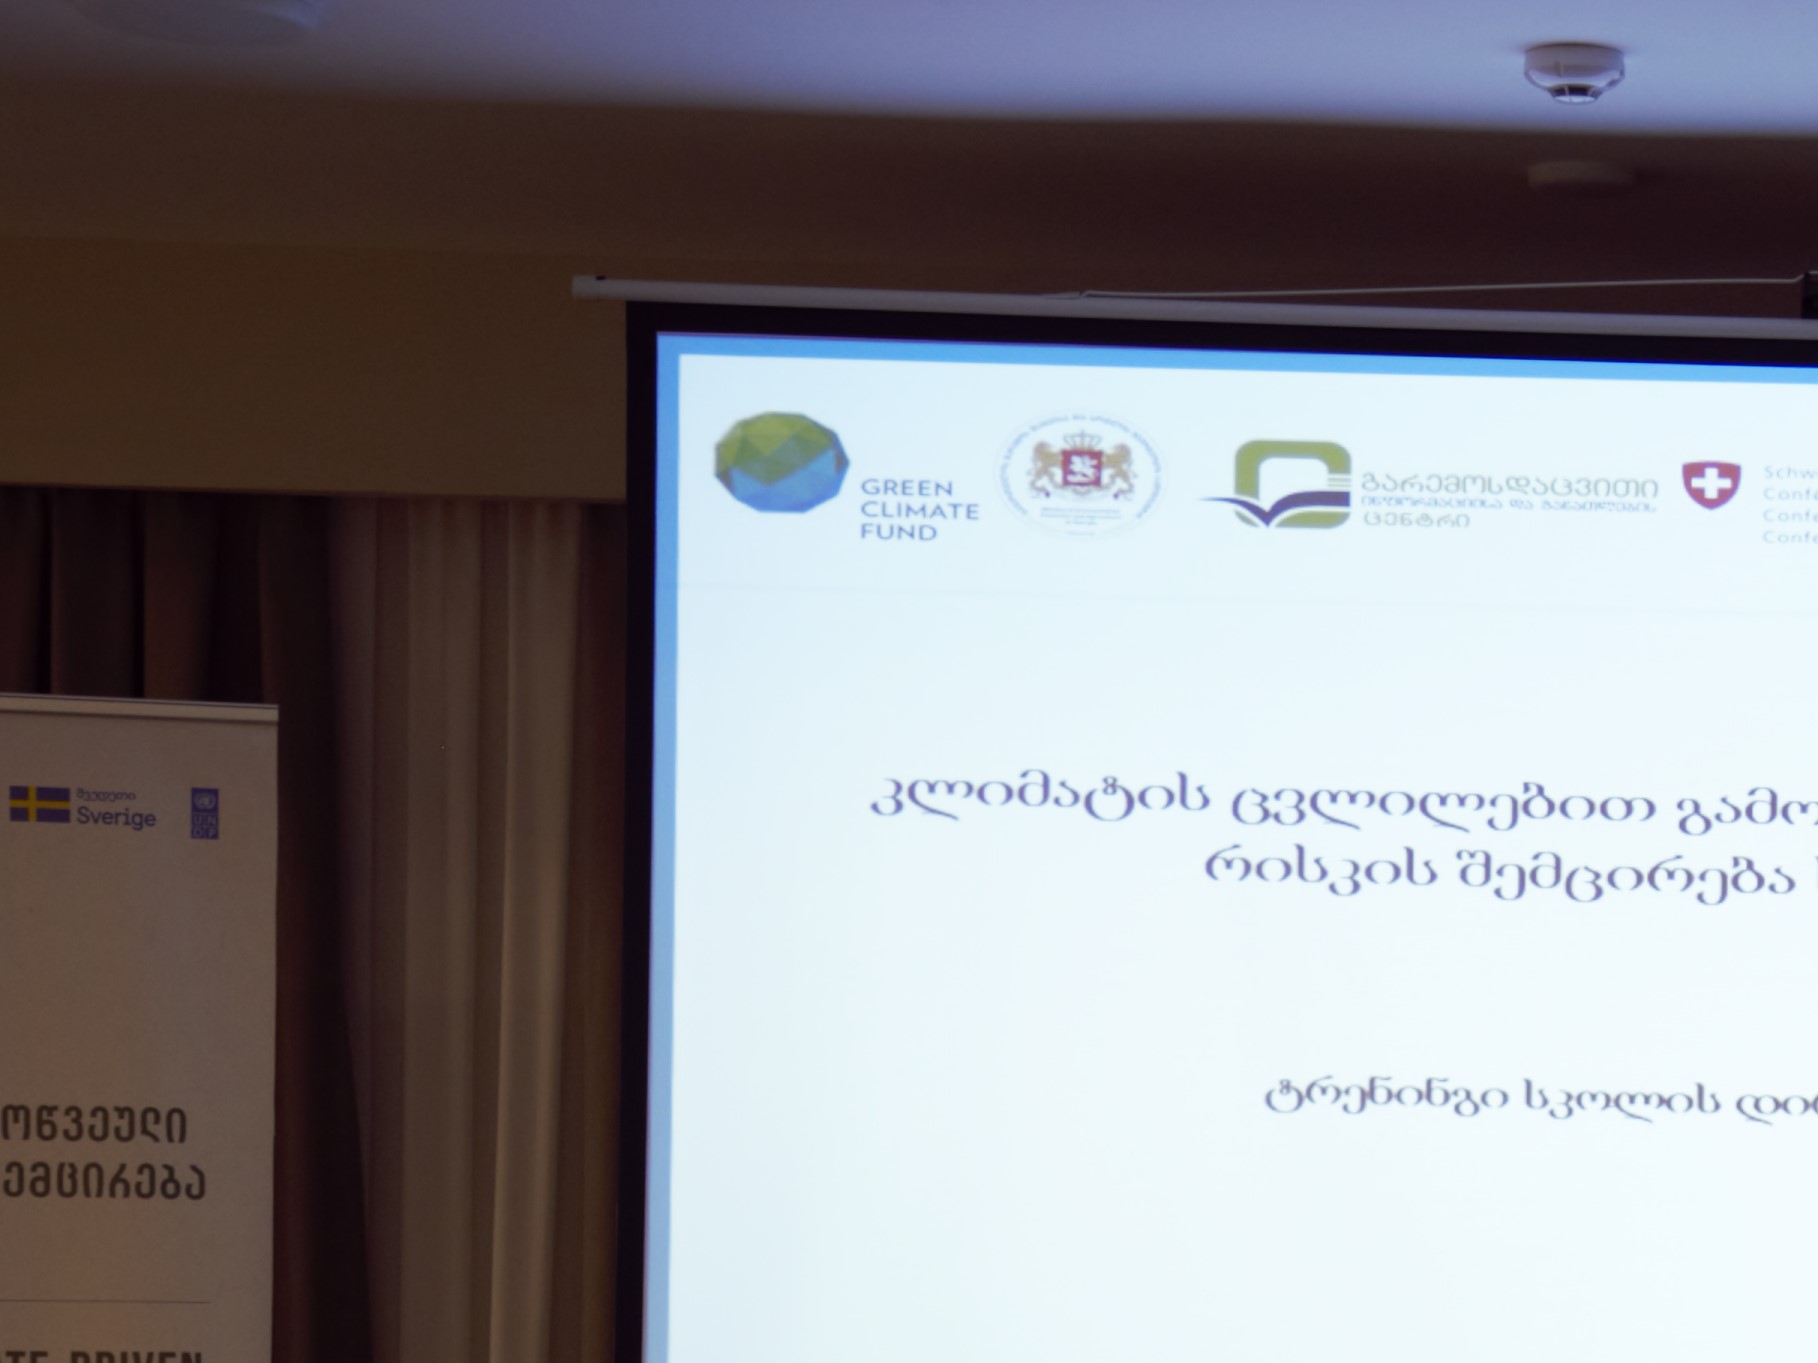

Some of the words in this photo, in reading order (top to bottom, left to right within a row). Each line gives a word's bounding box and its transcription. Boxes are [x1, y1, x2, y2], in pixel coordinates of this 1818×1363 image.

[860, 478, 953, 497] GREEN
[860, 500, 979, 521] CLIMATE
[860, 522, 938, 542] FUND
[77, 806, 157, 831] Sverige
[870, 769, 1211, 821] კლიმატის
[1231, 781, 1657, 833] ცვლილებით
[1205, 843, 1438, 896] რისკის
[1455, 849, 1796, 905] შემცირება
[1264, 1075, 1510, 1117] ტრენინგი
[1523, 1078, 1722, 1123] სკოლის
[0, 1103, 187, 1144] ოწვეული
[2, 1160, 206, 1201] ემცირება
